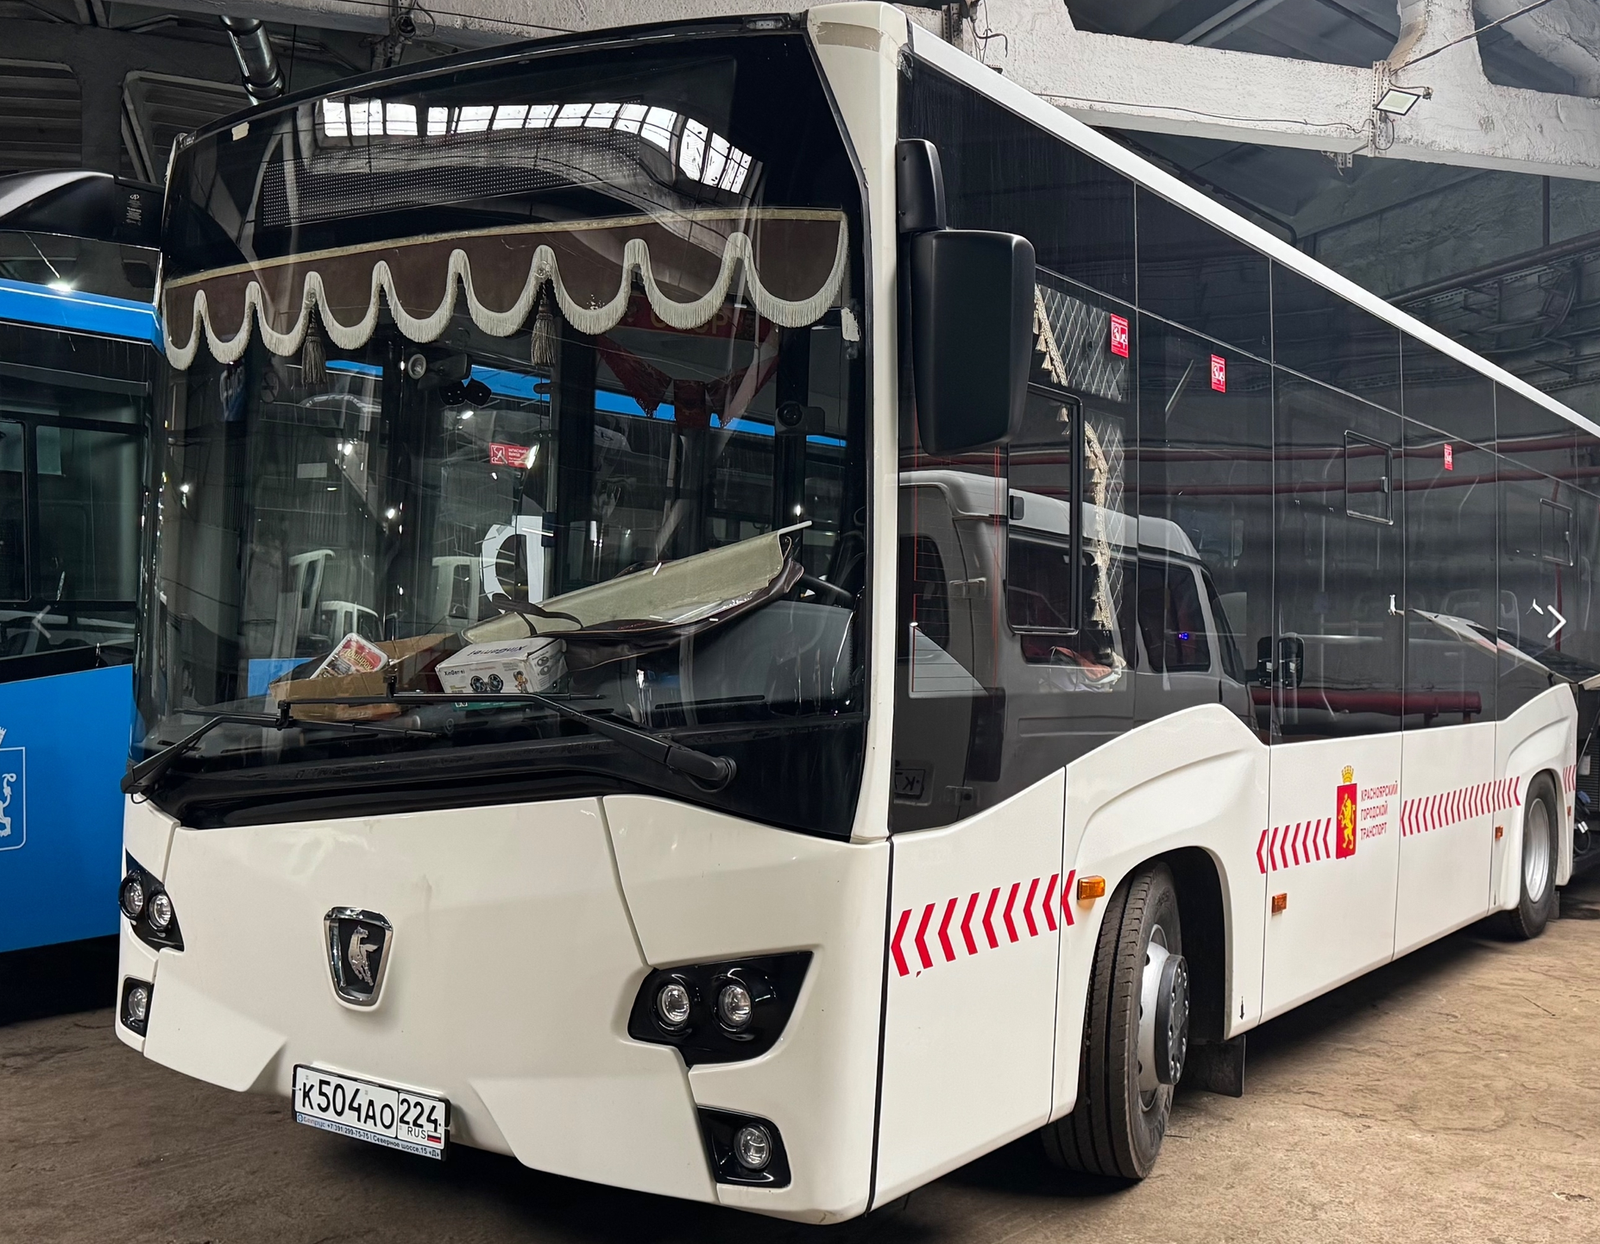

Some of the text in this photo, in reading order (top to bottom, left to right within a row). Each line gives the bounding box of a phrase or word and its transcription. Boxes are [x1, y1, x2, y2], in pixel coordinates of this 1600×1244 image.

[1361, 780, 1398, 802] КРАСНОЯРСКИЙ
[1361, 800, 1388, 821] ГОРОДСКОЙ
[1360, 822, 1387, 840] ТРАНСПОРТ
[399, 1097, 438, 1132] 224
[373, 1135, 400, 1148] Северное
[407, 1126, 427, 1140] RUS
